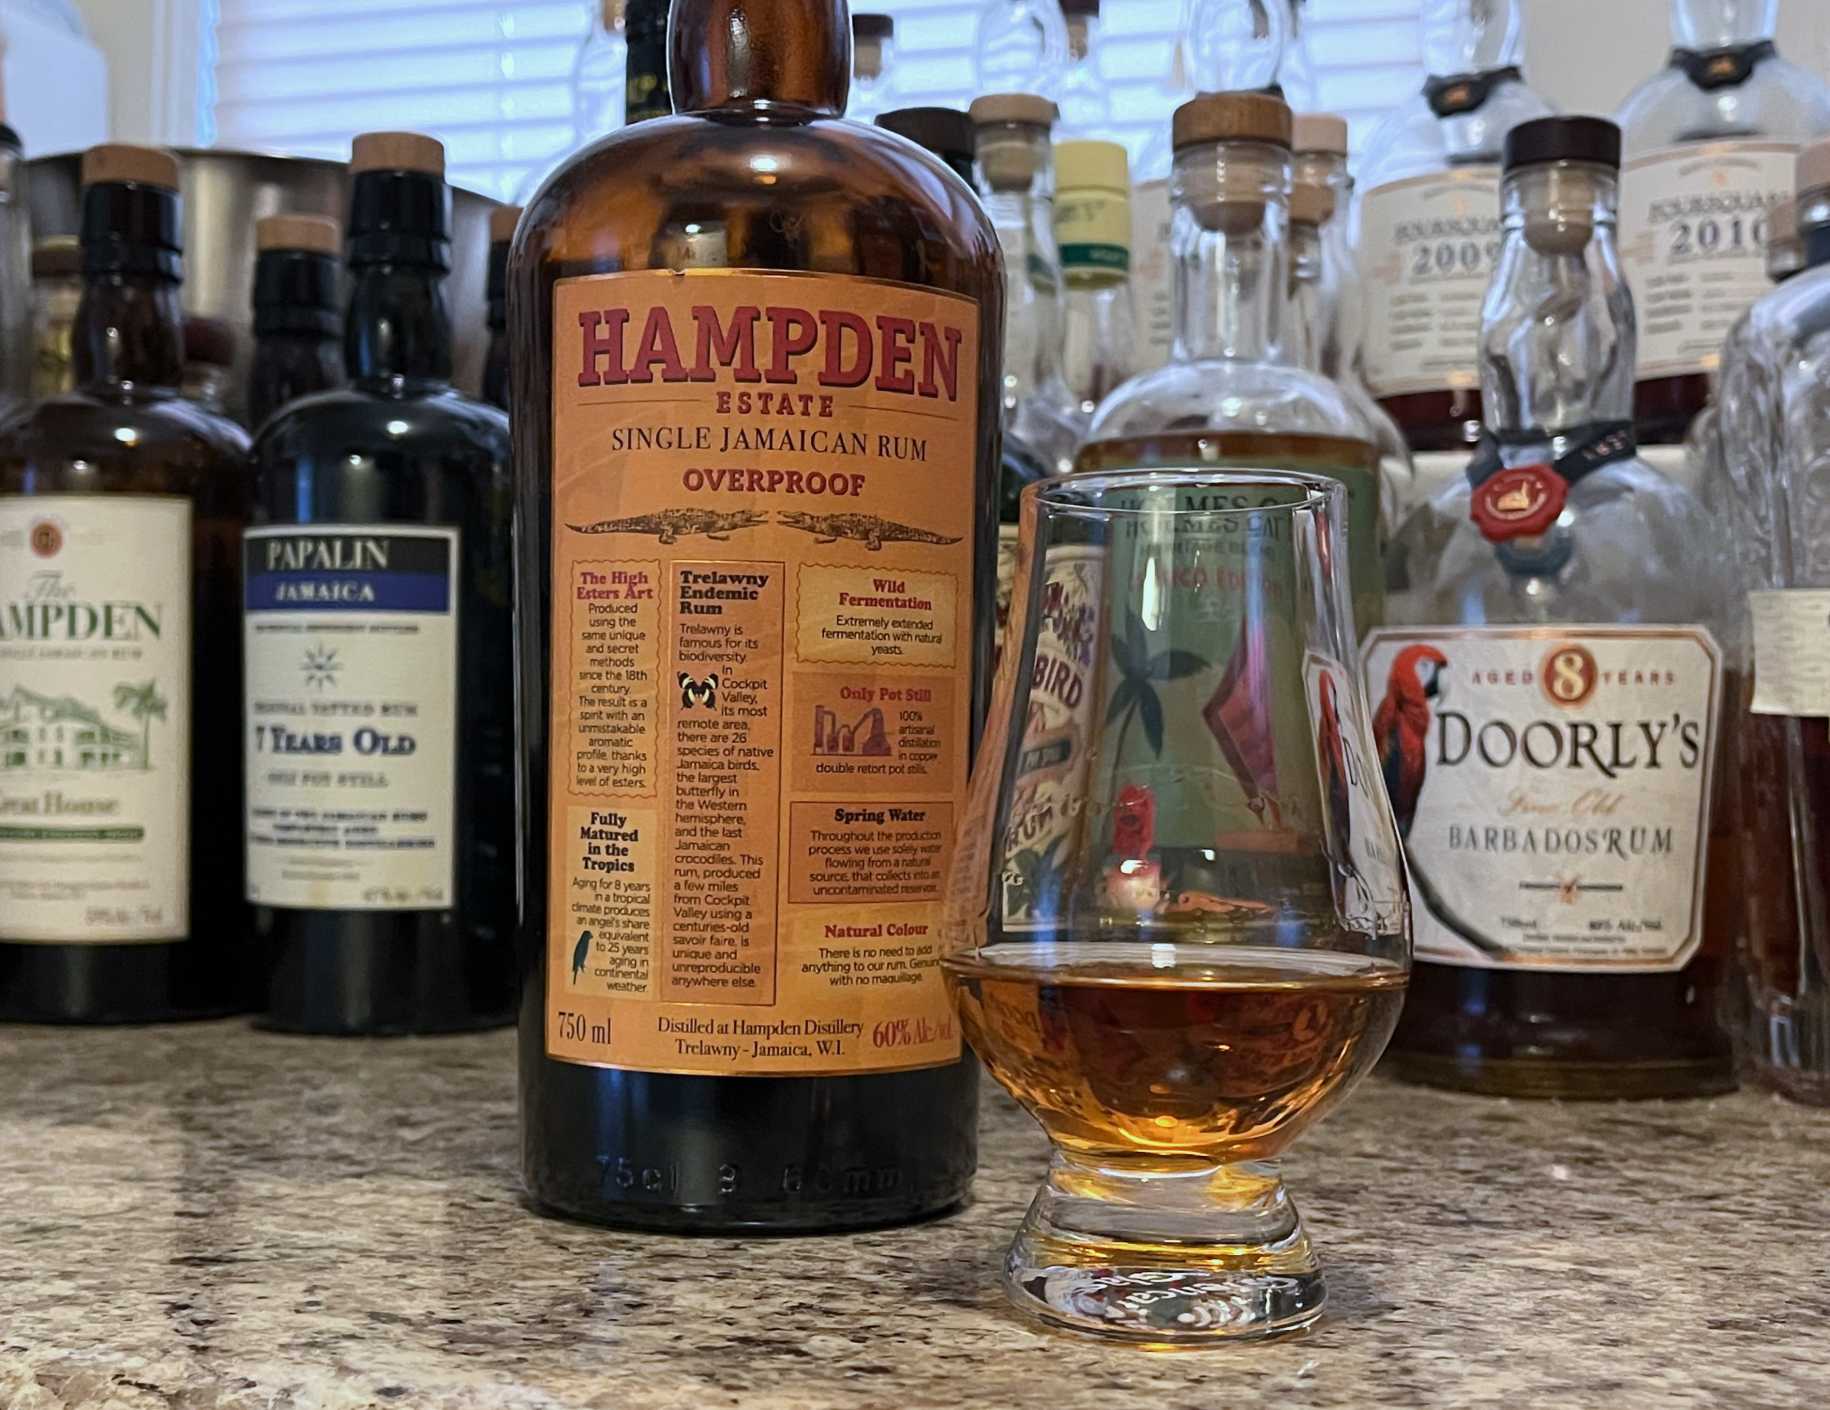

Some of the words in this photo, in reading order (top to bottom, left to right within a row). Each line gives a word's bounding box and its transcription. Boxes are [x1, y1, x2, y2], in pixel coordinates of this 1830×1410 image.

[578, 305, 962, 402] HAMPDEN
[716, 391, 834, 418] ESTATE
[611, 427, 711, 451] SINGLE
[720, 428, 867, 456] JAMAICAN
[878, 434, 927, 462] RUM
[682, 468, 865, 497] OVERPROOF
[267, 539, 391, 570] PAPALIN
[581, 572, 606, 584] The
[612, 571, 648, 586] High
[680, 570, 769, 588] Trelawny
[275, 580, 376, 602] JAMAICA
[577, 587, 619, 599] Esters
[624, 585, 653, 599] Art
[680, 585, 759, 600] Endemic
[873, 579, 905, 594] Wild
[588, 603, 638, 614] Produced
[680, 601, 722, 615] Rum
[839, 593, 932, 611] Fermentation
[589, 618, 615, 629] using
[619, 617, 636, 627] the
[836, 615, 889, 630] Extremely
[609, 630, 646, 641] unique
[680, 623, 730, 637] Trelawny
[734, 624, 743, 635] is
[822, 627, 890, 641] fermentation
[586, 644, 604, 654] and
[607, 644, 639, 654] secret
[679, 637, 722, 648] famous
[725, 637, 741, 648] for
[744, 638, 758, 649] its
[590, 657, 635, 667] methods
[605, 670, 622, 680] the
[625, 670, 648, 680] 18th
[722, 665, 733, 675] In
[1471, 671, 1532, 685] AGED
[1552, 650, 1584, 701] 8
[1602, 672, 1676, 686] YEARS
[721, 678, 768, 690] Cockpit
[1031, 655, 1082, 709] BIRD
[840, 686, 875, 702] Only
[880, 688, 901, 702] Pot
[721, 704, 735, 716] its
[737, 706, 768, 717] most
[677, 720, 719, 730] remote
[677, 731, 707, 743] there
[710, 734, 729, 743] are
[731, 732, 747, 744] 26
[722, 745, 735, 757] of
[737, 746, 774, 758] native
[1436, 711, 1700, 779] DOORLY'S
[611, 751, 647, 761] thanks
[597, 765, 619, 776] very
[622, 763, 646, 776] high
[676, 760, 725, 771] Jamaica
[815, 762, 855, 774] double
[676, 772, 695, 783] the
[698, 772, 737, 786] largest
[675, 785, 726, 799] butterfly
[728, 787, 740, 797] in
[675, 799, 694, 810] the
[697, 799, 748, 811] Western
[590, 811, 626, 829] Fully
[834, 808, 885, 825] Spring
[888, 808, 927, 823] Water
[580, 826, 639, 843] Matured
[674, 826, 697, 837] and
[700, 826, 720, 838] the
[721, 826, 743, 838] last
[810, 830, 875, 843] Throughout
[877, 831, 894, 841] the
[674, 839, 730, 851] Jamaican
[1448, 826, 1600, 854] BARBADOS
[1601, 827, 1673, 860] RUM
[587, 843, 601, 856] in
[605, 843, 629, 857] the
[808, 845, 852, 857] process
[854, 846, 871, 855] we
[582, 857, 635, 873] Tropics
[739, 853, 764, 866] This
[824, 858, 864, 870] flowing
[867, 857, 891, 868] from
[703, 868, 761, 880] produced
[852, 871, 872, 881] that
[599, 878, 613, 889] for
[623, 882, 650, 893] years
[684, 880, 705, 891] few
[707, 881, 739, 892] miles
[673, 893, 701, 905] from
[704, 894, 750, 907] Cockpit
[673, 907, 707, 920] Valley
[710, 909, 742, 921] using
[745, 911, 753, 920] a
[824, 924, 883, 938] Natural
[886, 923, 929, 937] Colour
[608, 942, 619, 953] 25
[741, 936, 750, 947] is
[672, 949, 712, 960] unique
[715, 949, 737, 960] and
[818, 947, 850, 959] There
[863, 949, 877, 958] no
[672, 962, 761, 974] unreproducible
[801, 961, 851, 974] anything
[853, 961, 865, 972] to
[671, 976, 729, 988] anywhere
[829, 975, 853, 986] with
[856, 976, 869, 986] no
[558, 1011, 587, 1043] 750
[592, 1016, 611, 1046] ml
[658, 1016, 714, 1035] Distilled
[717, 1023, 729, 1035] at
[733, 1019, 801, 1040] Hampden
[803, 1019, 864, 1038] Distillery
[873, 1018, 911, 1049] 60%
[675, 1039, 740, 1061] Trelawny
[752, 1041, 812, 1058] Jamaica,
[816, 1039, 845, 1056] W.I.
